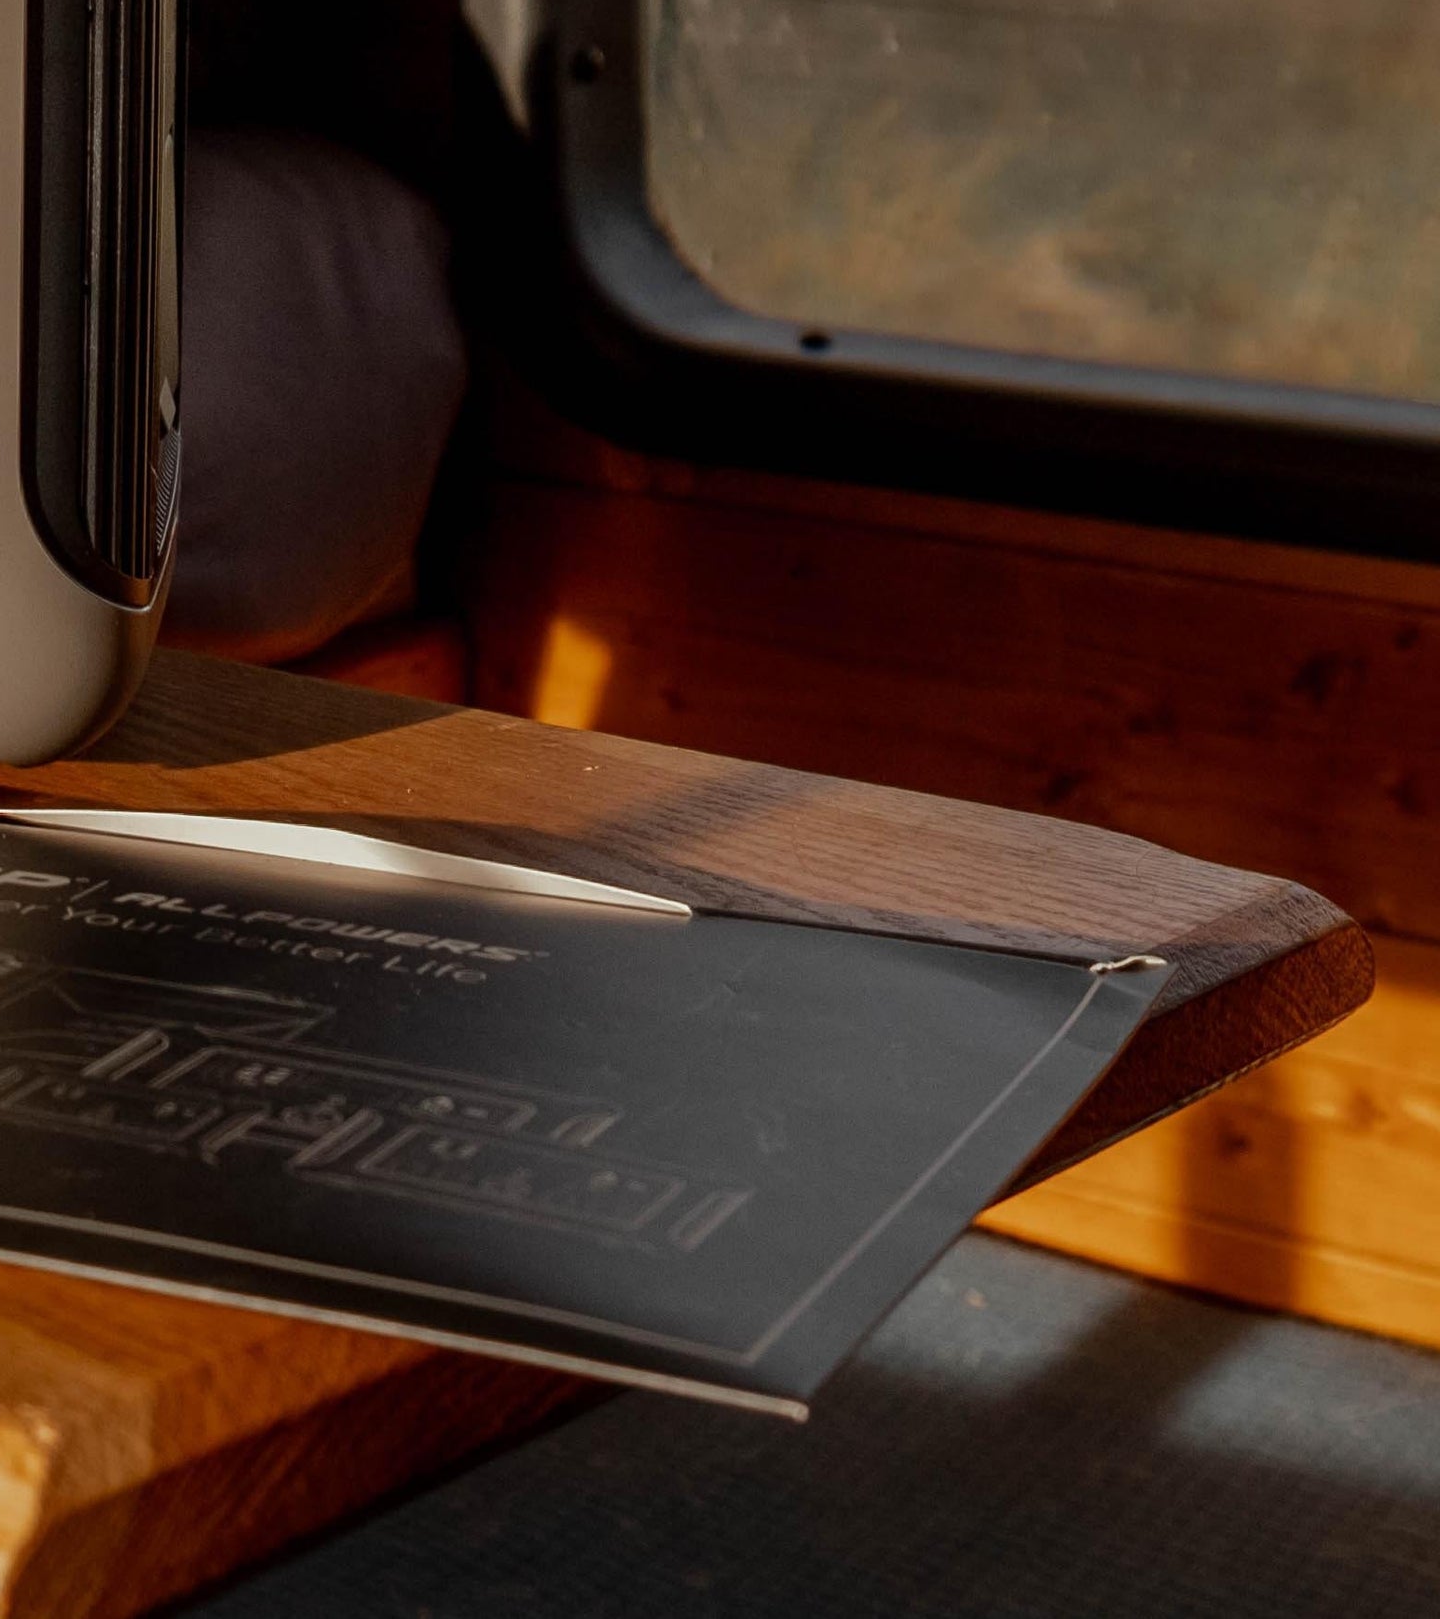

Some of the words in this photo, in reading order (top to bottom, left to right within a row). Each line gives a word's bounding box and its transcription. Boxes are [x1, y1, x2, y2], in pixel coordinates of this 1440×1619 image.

[64, 906, 184, 934] Your
[195, 926, 374, 964] Better
[383, 954, 487, 984] Life
[113, 892, 530, 961] ALLPOWERS
